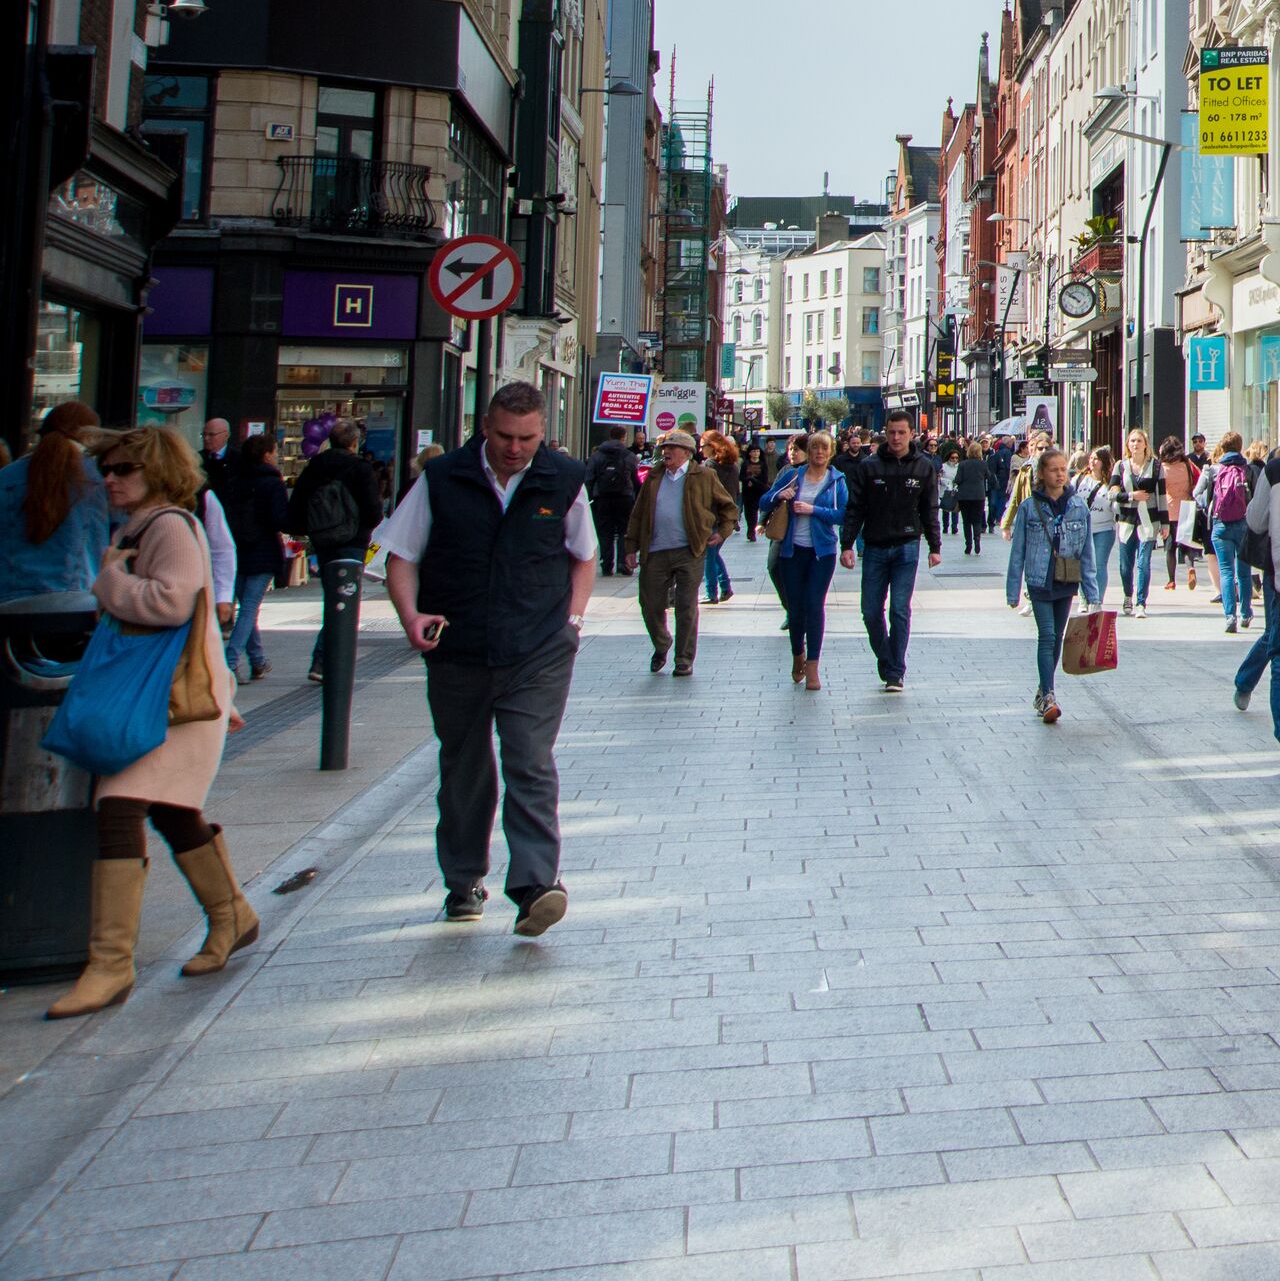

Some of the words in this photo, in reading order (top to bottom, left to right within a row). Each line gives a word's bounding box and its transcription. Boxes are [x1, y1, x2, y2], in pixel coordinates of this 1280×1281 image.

[1208, 77, 1231, 91] TO
[1237, 76, 1262, 90] LET
[1203, 97, 1229, 107] Fitted
[1232, 96, 1267, 106] Offices
[1207, 114, 1220, 122] 60
[1230, 113, 1247, 121] 178
[1202, 131, 1214, 142] 01
[1220, 130, 1267, 142] 6611233
[345, 297, 362, 314] H
[658, 386, 696, 399] smiggle
